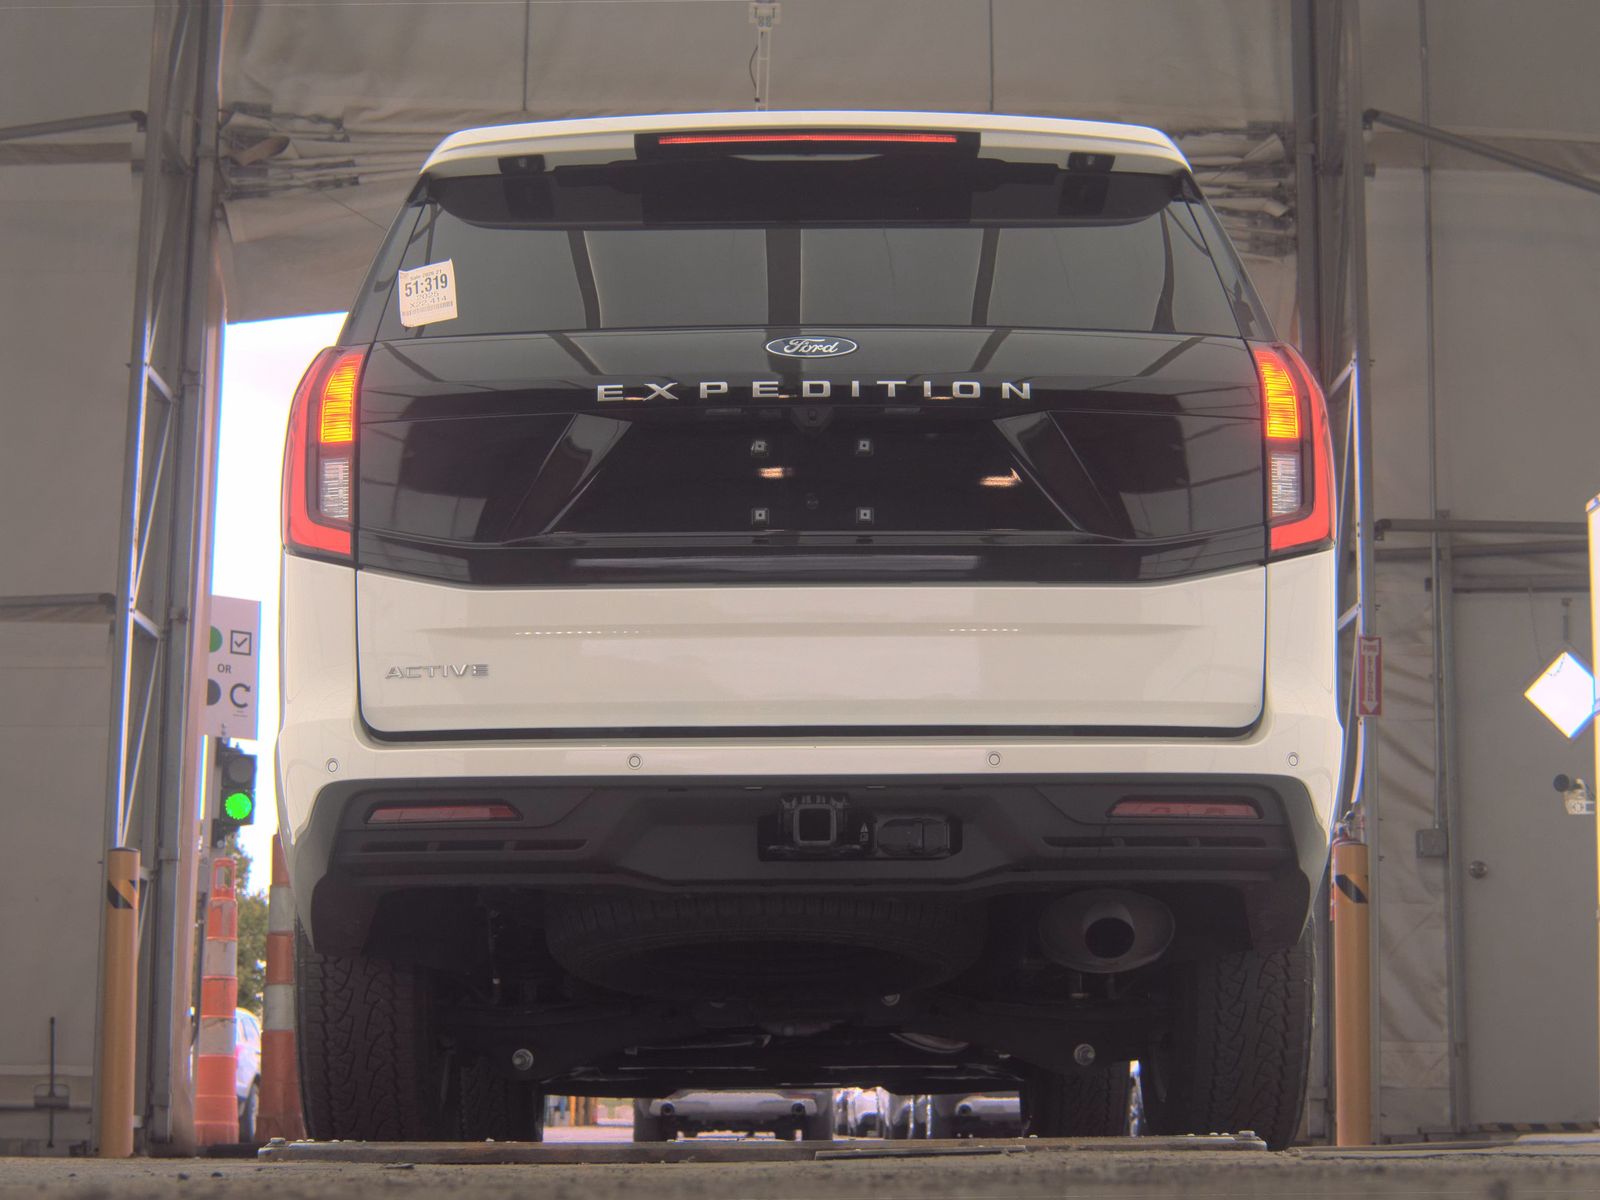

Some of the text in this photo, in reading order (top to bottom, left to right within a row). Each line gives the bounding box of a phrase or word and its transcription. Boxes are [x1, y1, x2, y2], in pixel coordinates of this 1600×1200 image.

[404, 273, 448, 297] 51:319
[783, 338, 840, 354] Ford
[596, 380, 1031, 402] EXPEDITION
[217, 663, 232, 674] OR
[384, 663, 489, 680] ACTIVE
